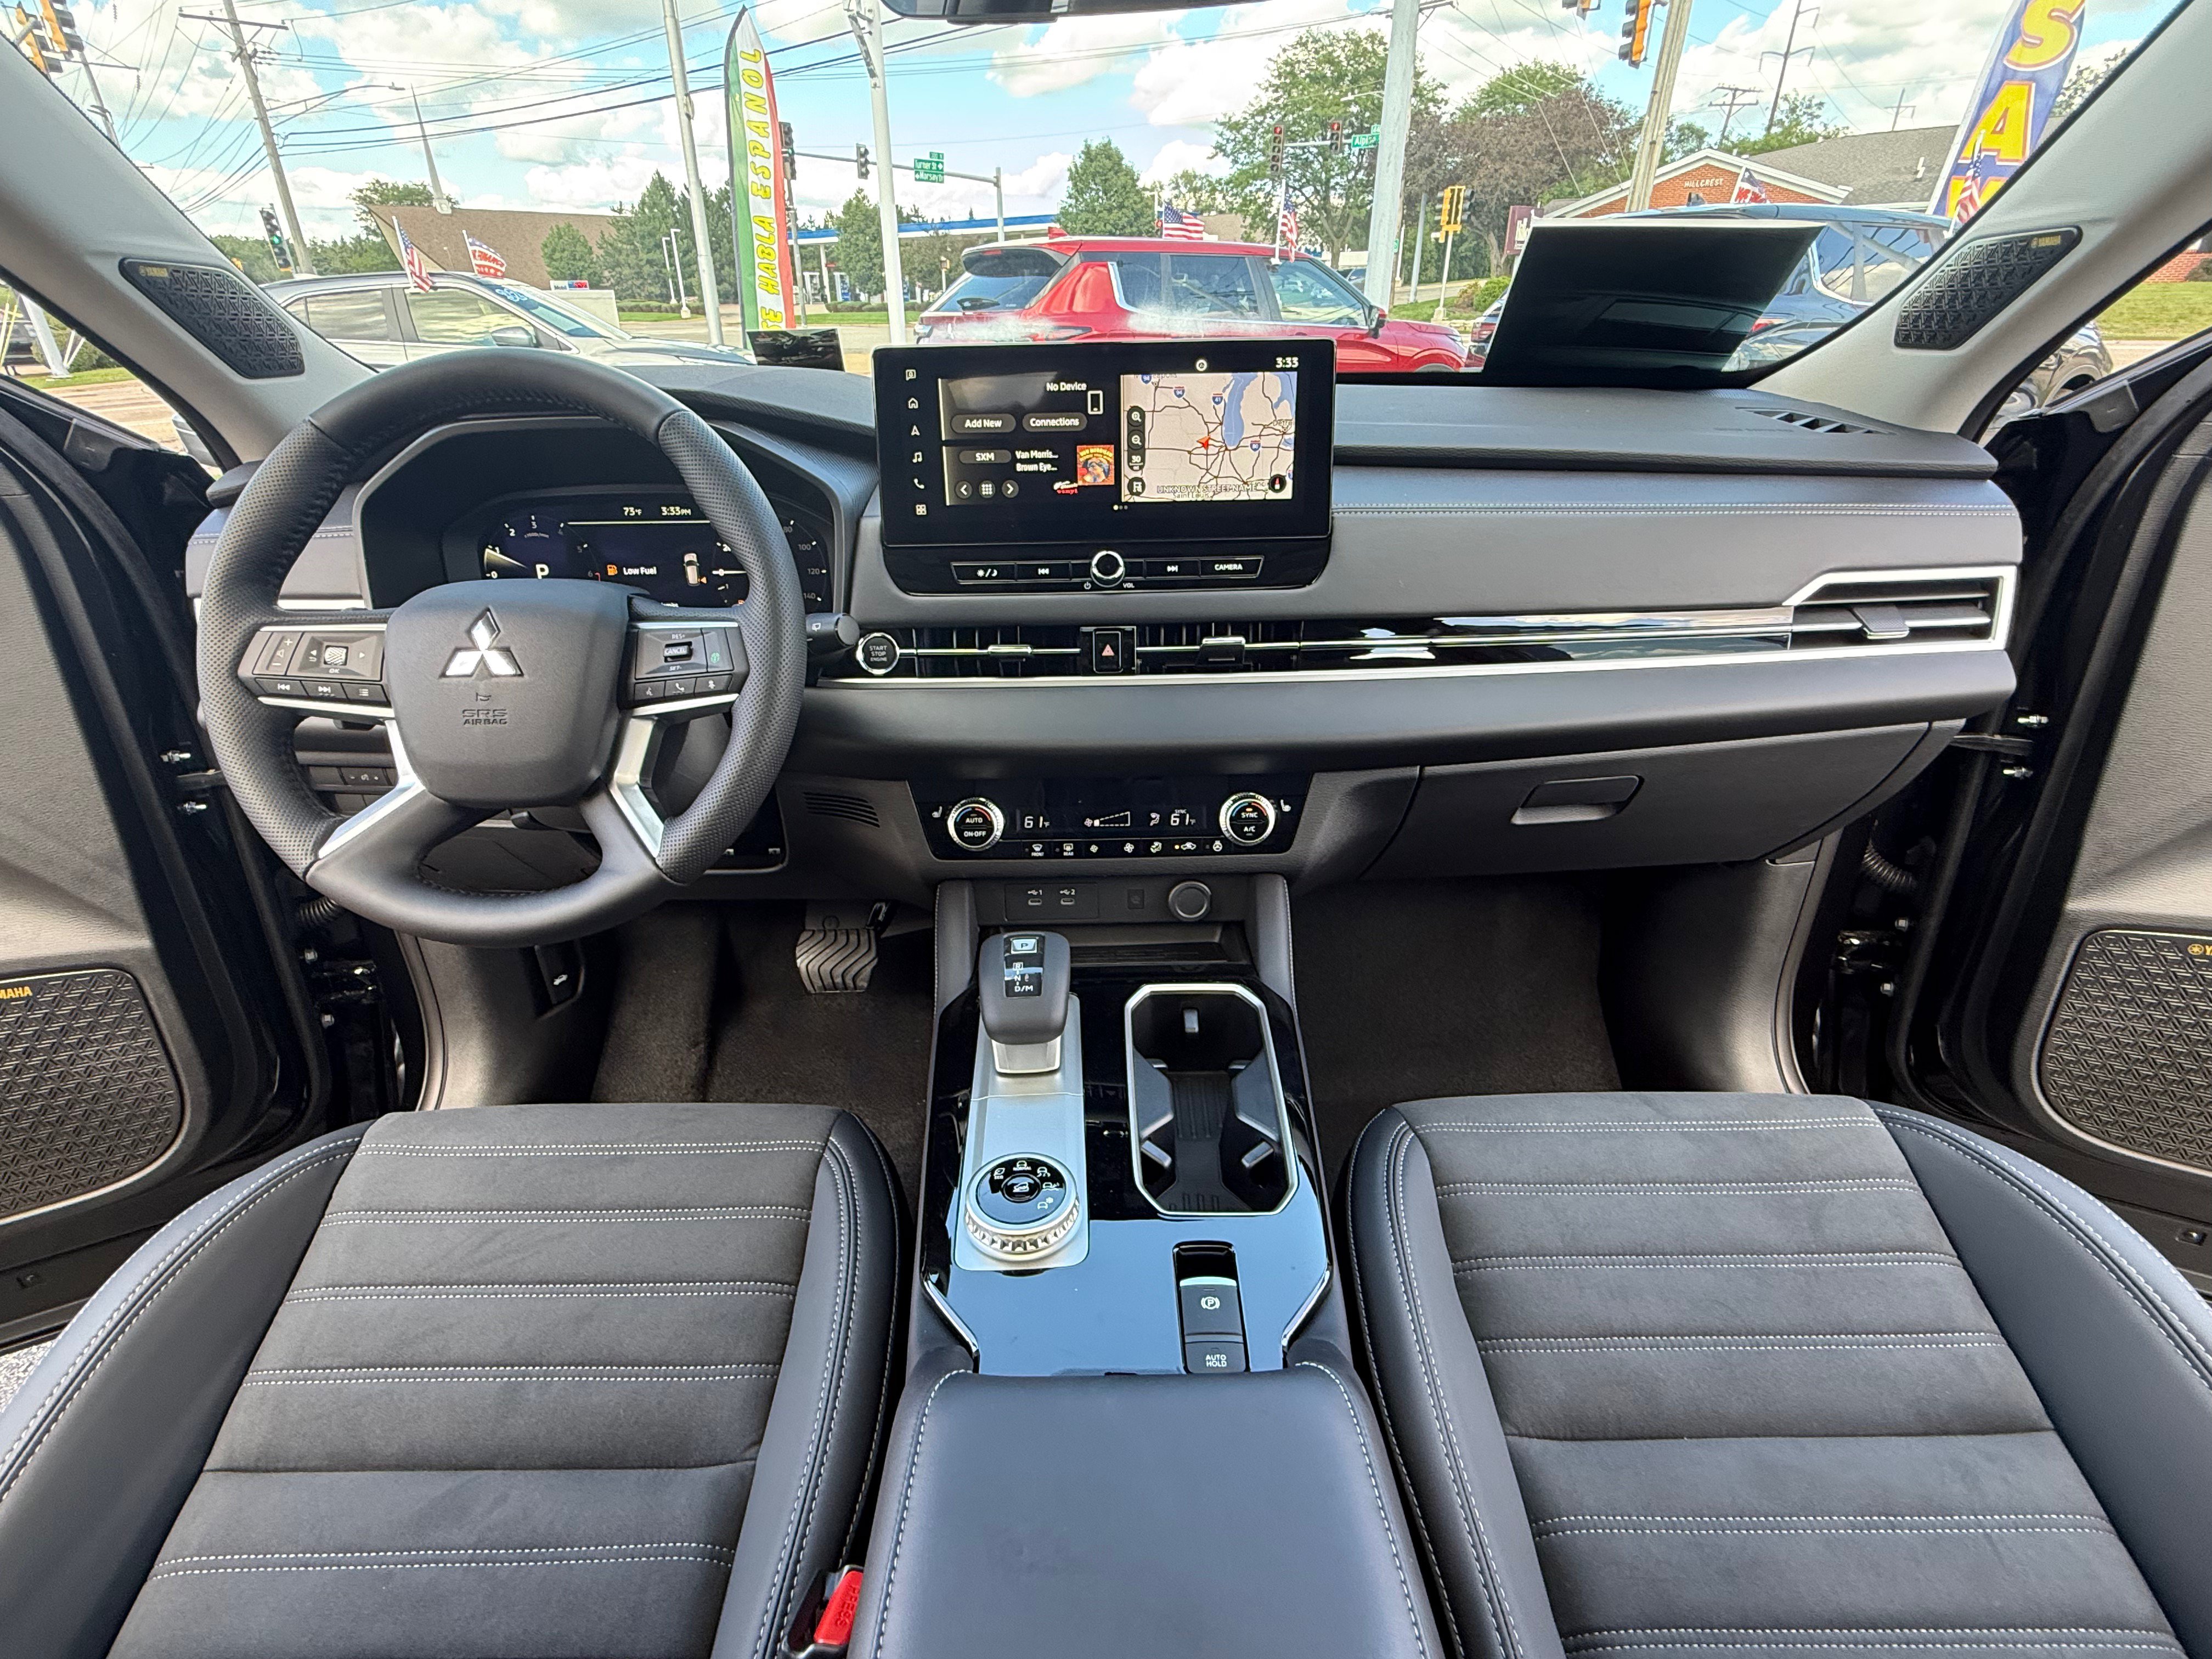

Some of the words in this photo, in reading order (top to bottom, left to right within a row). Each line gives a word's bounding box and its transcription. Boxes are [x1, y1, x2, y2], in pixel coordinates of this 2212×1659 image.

[735, 48, 771, 199] ESPAÑOL
[1684, 178, 1724, 188] HILLCREST
[753, 215, 780, 295] HABLA
[1276, 357, 1299, 368] 3:33
[1046, 382, 1059, 391] No
[1060, 382, 1087, 391] Device
[964, 419, 982, 428] Add
[983, 419, 1002, 428] New
[1029, 417, 1080, 427] Connections
[975, 452, 995, 461] SXM
[1015, 450, 1029, 459] Van
[1131, 455, 1142, 463] 30
[1016, 462, 1039, 472] Brown
[1156, 484, 1203, 494] UNKNOWN
[1203, 484, 1230, 493] STREET
[1230, 483, 1257, 493] NAME
[509, 528, 516, 537] 2
[535, 564, 549, 579] P
[623, 567, 639, 575] Low
[640, 566, 657, 575] Fuel
[1215, 563, 1243, 571] CAMERA
[462, 709, 508, 718] SRS
